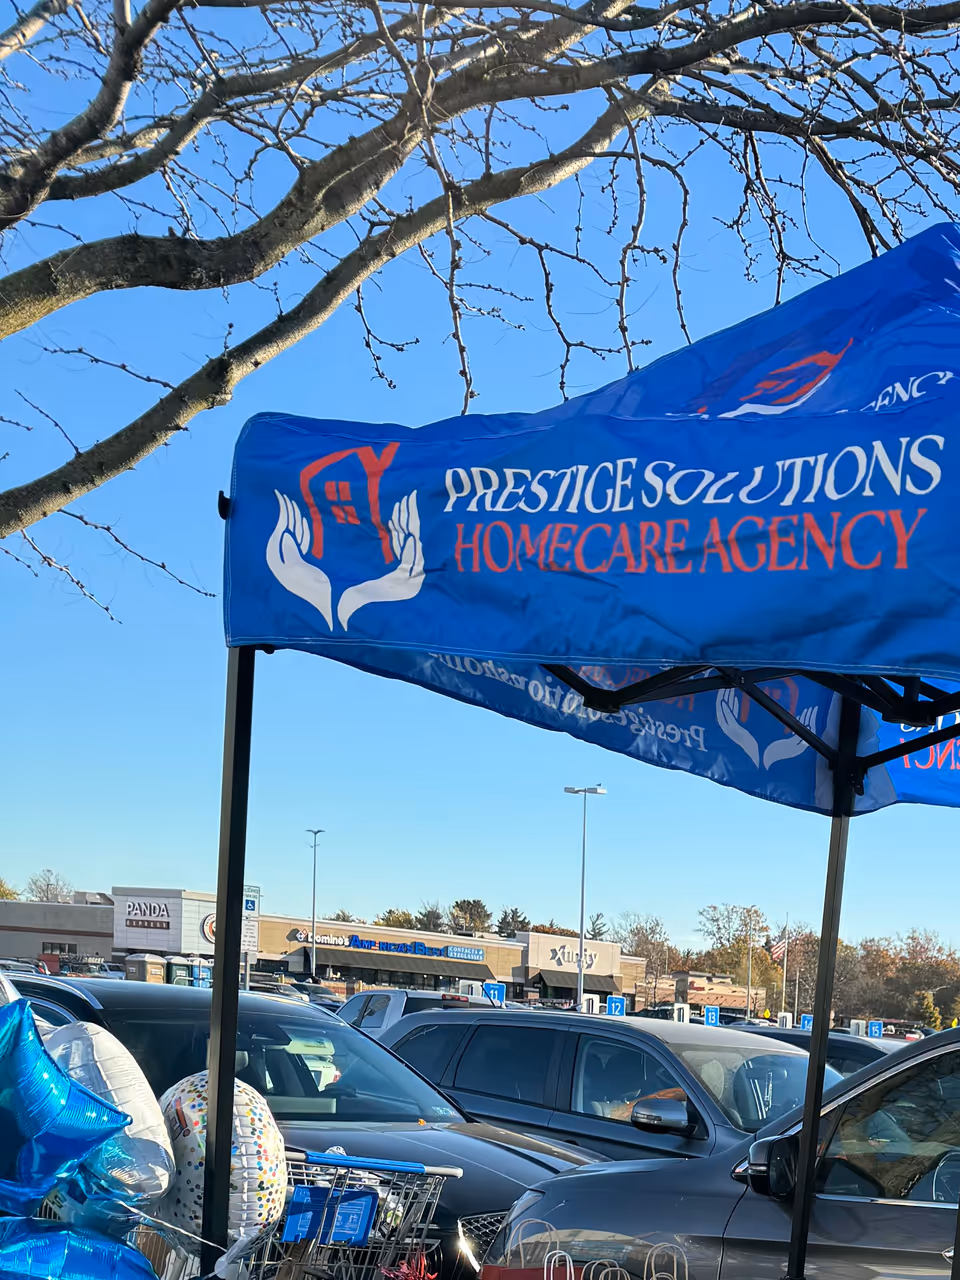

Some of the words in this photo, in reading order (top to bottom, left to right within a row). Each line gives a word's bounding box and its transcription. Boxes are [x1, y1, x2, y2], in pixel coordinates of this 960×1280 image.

[443, 456, 636, 514] PRESTIGE
[640, 434, 945, 507] SOLUTIONS
[453, 518, 693, 573] HOMECARE
[702, 508, 929, 572] AGENCY
[126, 902, 169, 917] PANDA
[307, 933, 349, 946] Domino's
[611, 1002, 621, 1016] 12
[708, 1011, 716, 1023] 13
[872, 1026, 880, 1036] 15
